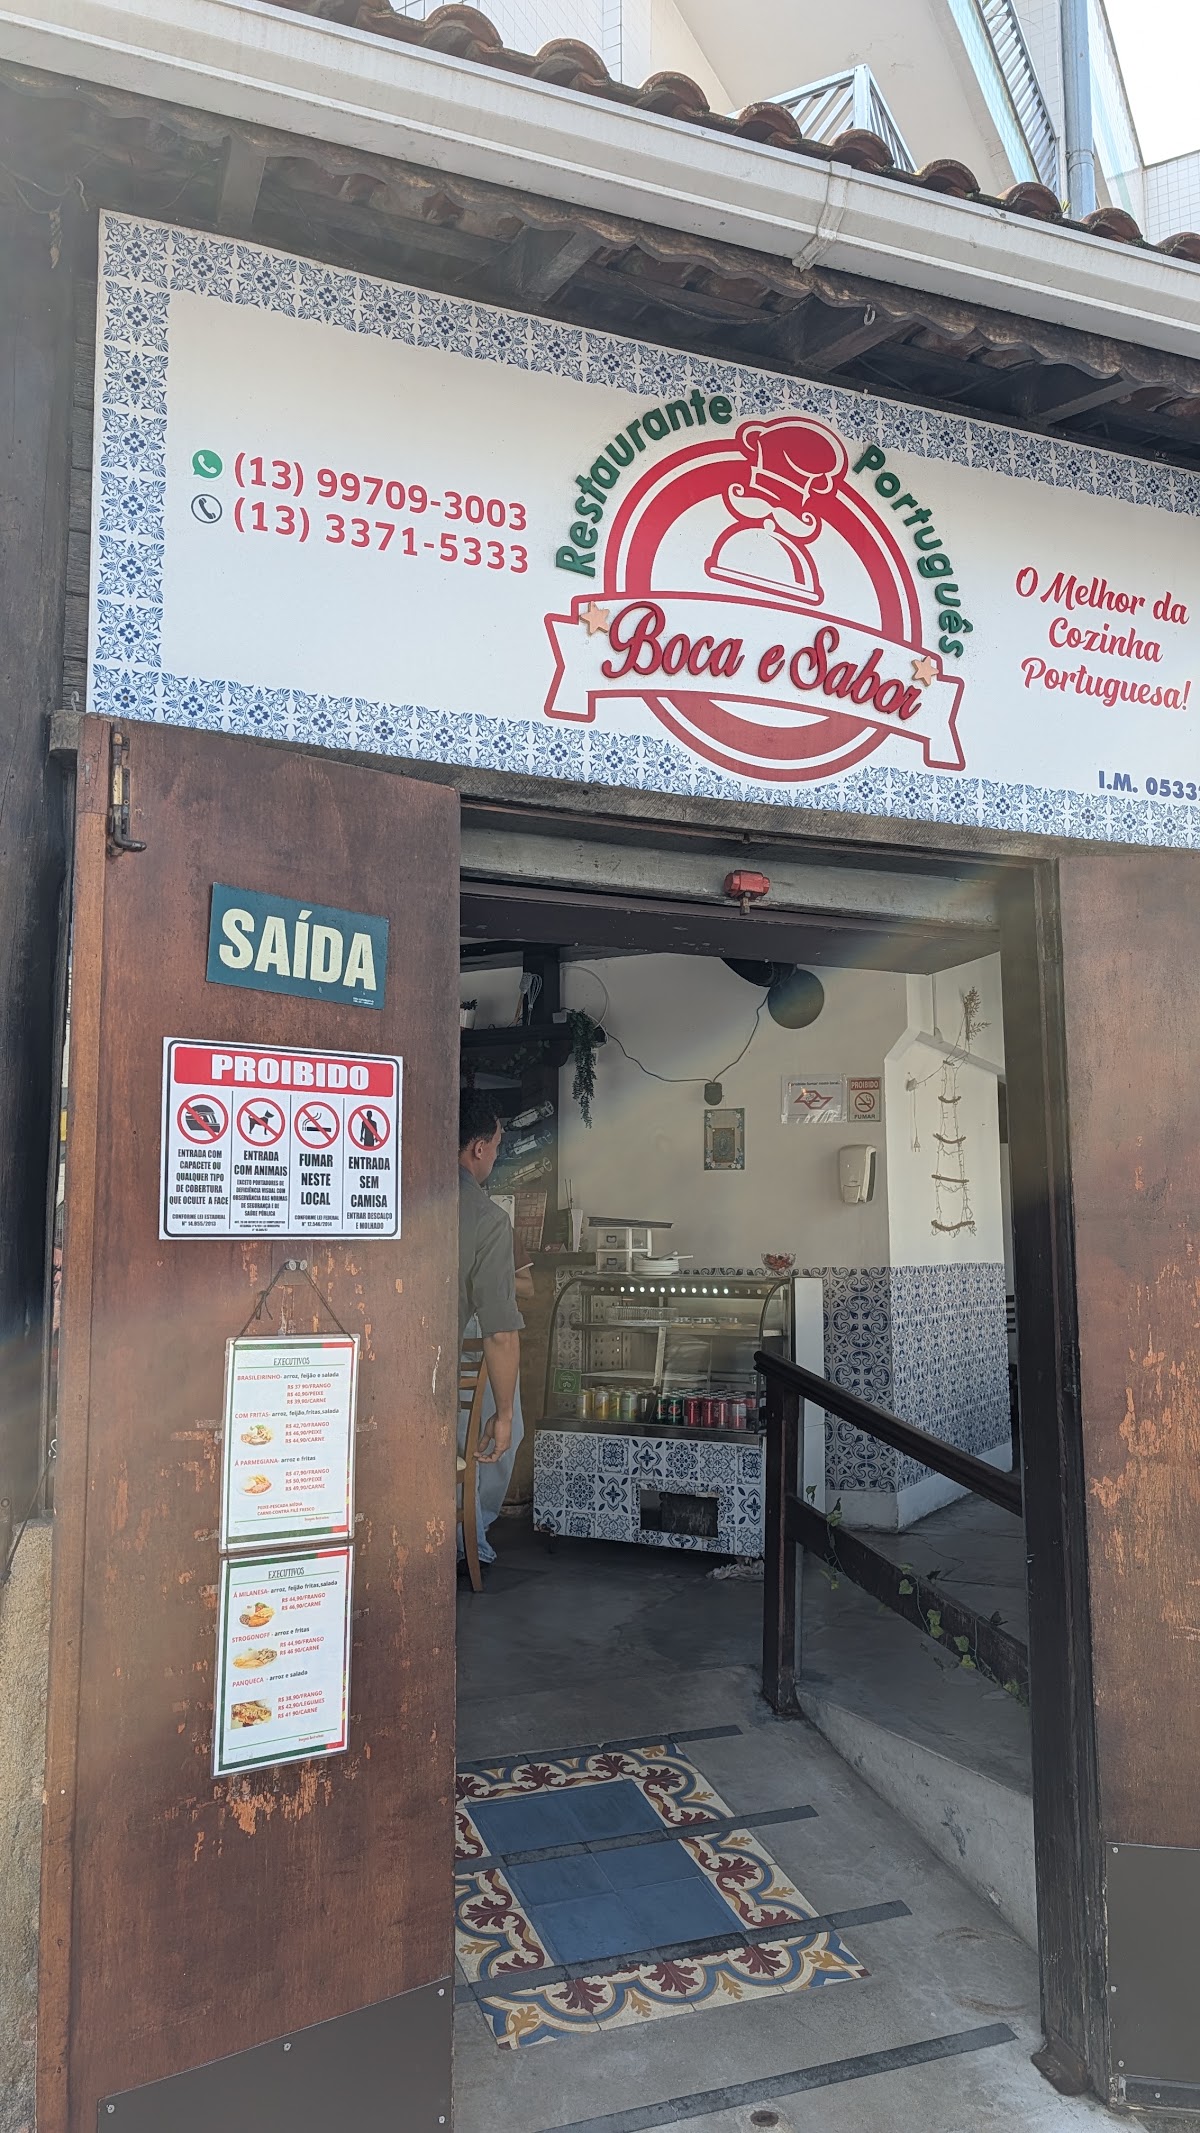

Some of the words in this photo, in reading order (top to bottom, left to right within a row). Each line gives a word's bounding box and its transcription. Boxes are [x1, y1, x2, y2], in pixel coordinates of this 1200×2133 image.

[554, 389, 733, 578] Restaurante
[234, 452, 304, 497] (13)
[317, 468, 527, 531] 99709-3003
[234, 497, 310, 542] (13)
[326, 514, 528, 574] 3371-5333
[852, 444, 974, 658] Português
[1016, 566, 1038, 598] O
[1040, 572, 1146, 616] Melhor
[1152, 591, 1190, 625] da
[1049, 616, 1164, 663] Cozinha
[602, 601, 745, 680] Boca
[758, 644, 786, 683] e
[789, 625, 922, 721] Sabor
[1021, 657, 1192, 710] Portuguesa!
[1098, 770, 1138, 793] I.M.
[1146, 776, 1200, 802] 0533
[219, 908, 377, 990] SAÍDA
[211, 1054, 370, 1090] PROIBIDO
[851, 1081, 879, 1089] PROIBIDO
[178, 1148, 206, 1158] ENTRADA
[208, 1150, 222, 1158] COM
[244, 1150, 279, 1161] ENTRADA
[180, 1160, 211, 1170] CAPACETE
[212, 1162, 222, 1170] OU
[299, 1153, 333, 1168] FUMAR
[348, 1156, 391, 1170] ENTRADA
[176, 1172, 208, 1182] QUALQUER
[210, 1174, 224, 1182] TIPO
[234, 1164, 253, 1175] COM
[254, 1165, 288, 1176] ANIMAIS
[301, 1172, 331, 1186] NESTE
[359, 1175, 379, 1189] SEM
[176, 1184, 184, 1193] DE
[185, 1184, 222, 1193] COBERTURA
[169, 1196, 182, 1205] QUE
[183, 1196, 206, 1205] OCULTE
[214, 1197, 228, 1205] FACE
[300, 1191, 331, 1206] LOCAL
[350, 1194, 388, 1208] CAMISA
[367, 1212, 392, 1221] DESCALÇO
[274, 1357, 310, 1366] EXECUTIVOS
[268, 1567, 304, 1579] EXECUTIVOS
[288, 1584, 303, 1592] feijão
[232, 1633, 270, 1643] STROGONOFF
[287, 1645, 320, 1654] 4690/CARNE
[232, 1677, 264, 1687] PANQUECA
[285, 1707, 318, 1717] 4190/CARNE
